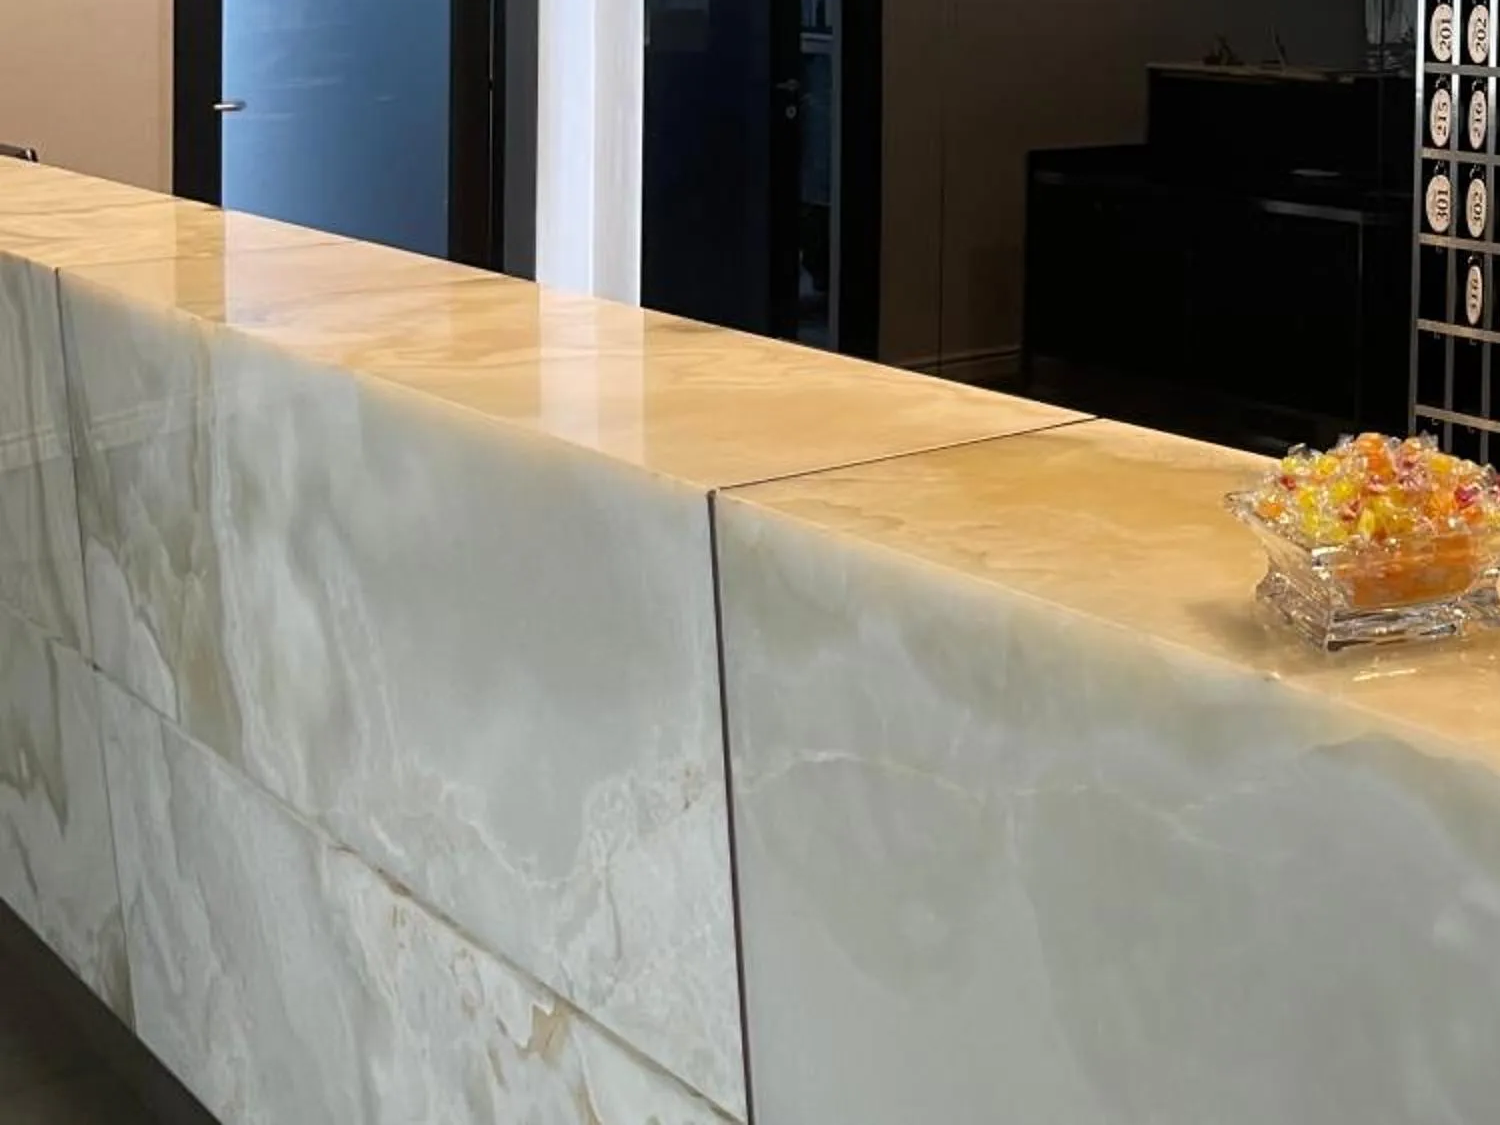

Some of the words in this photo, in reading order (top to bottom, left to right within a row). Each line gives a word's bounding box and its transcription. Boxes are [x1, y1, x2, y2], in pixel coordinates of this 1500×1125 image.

[1439, 18, 1453, 52] 201
[1476, 17, 1489, 52] 202
[1436, 101, 1448, 136] 215
[1436, 190, 1449, 223] 301
